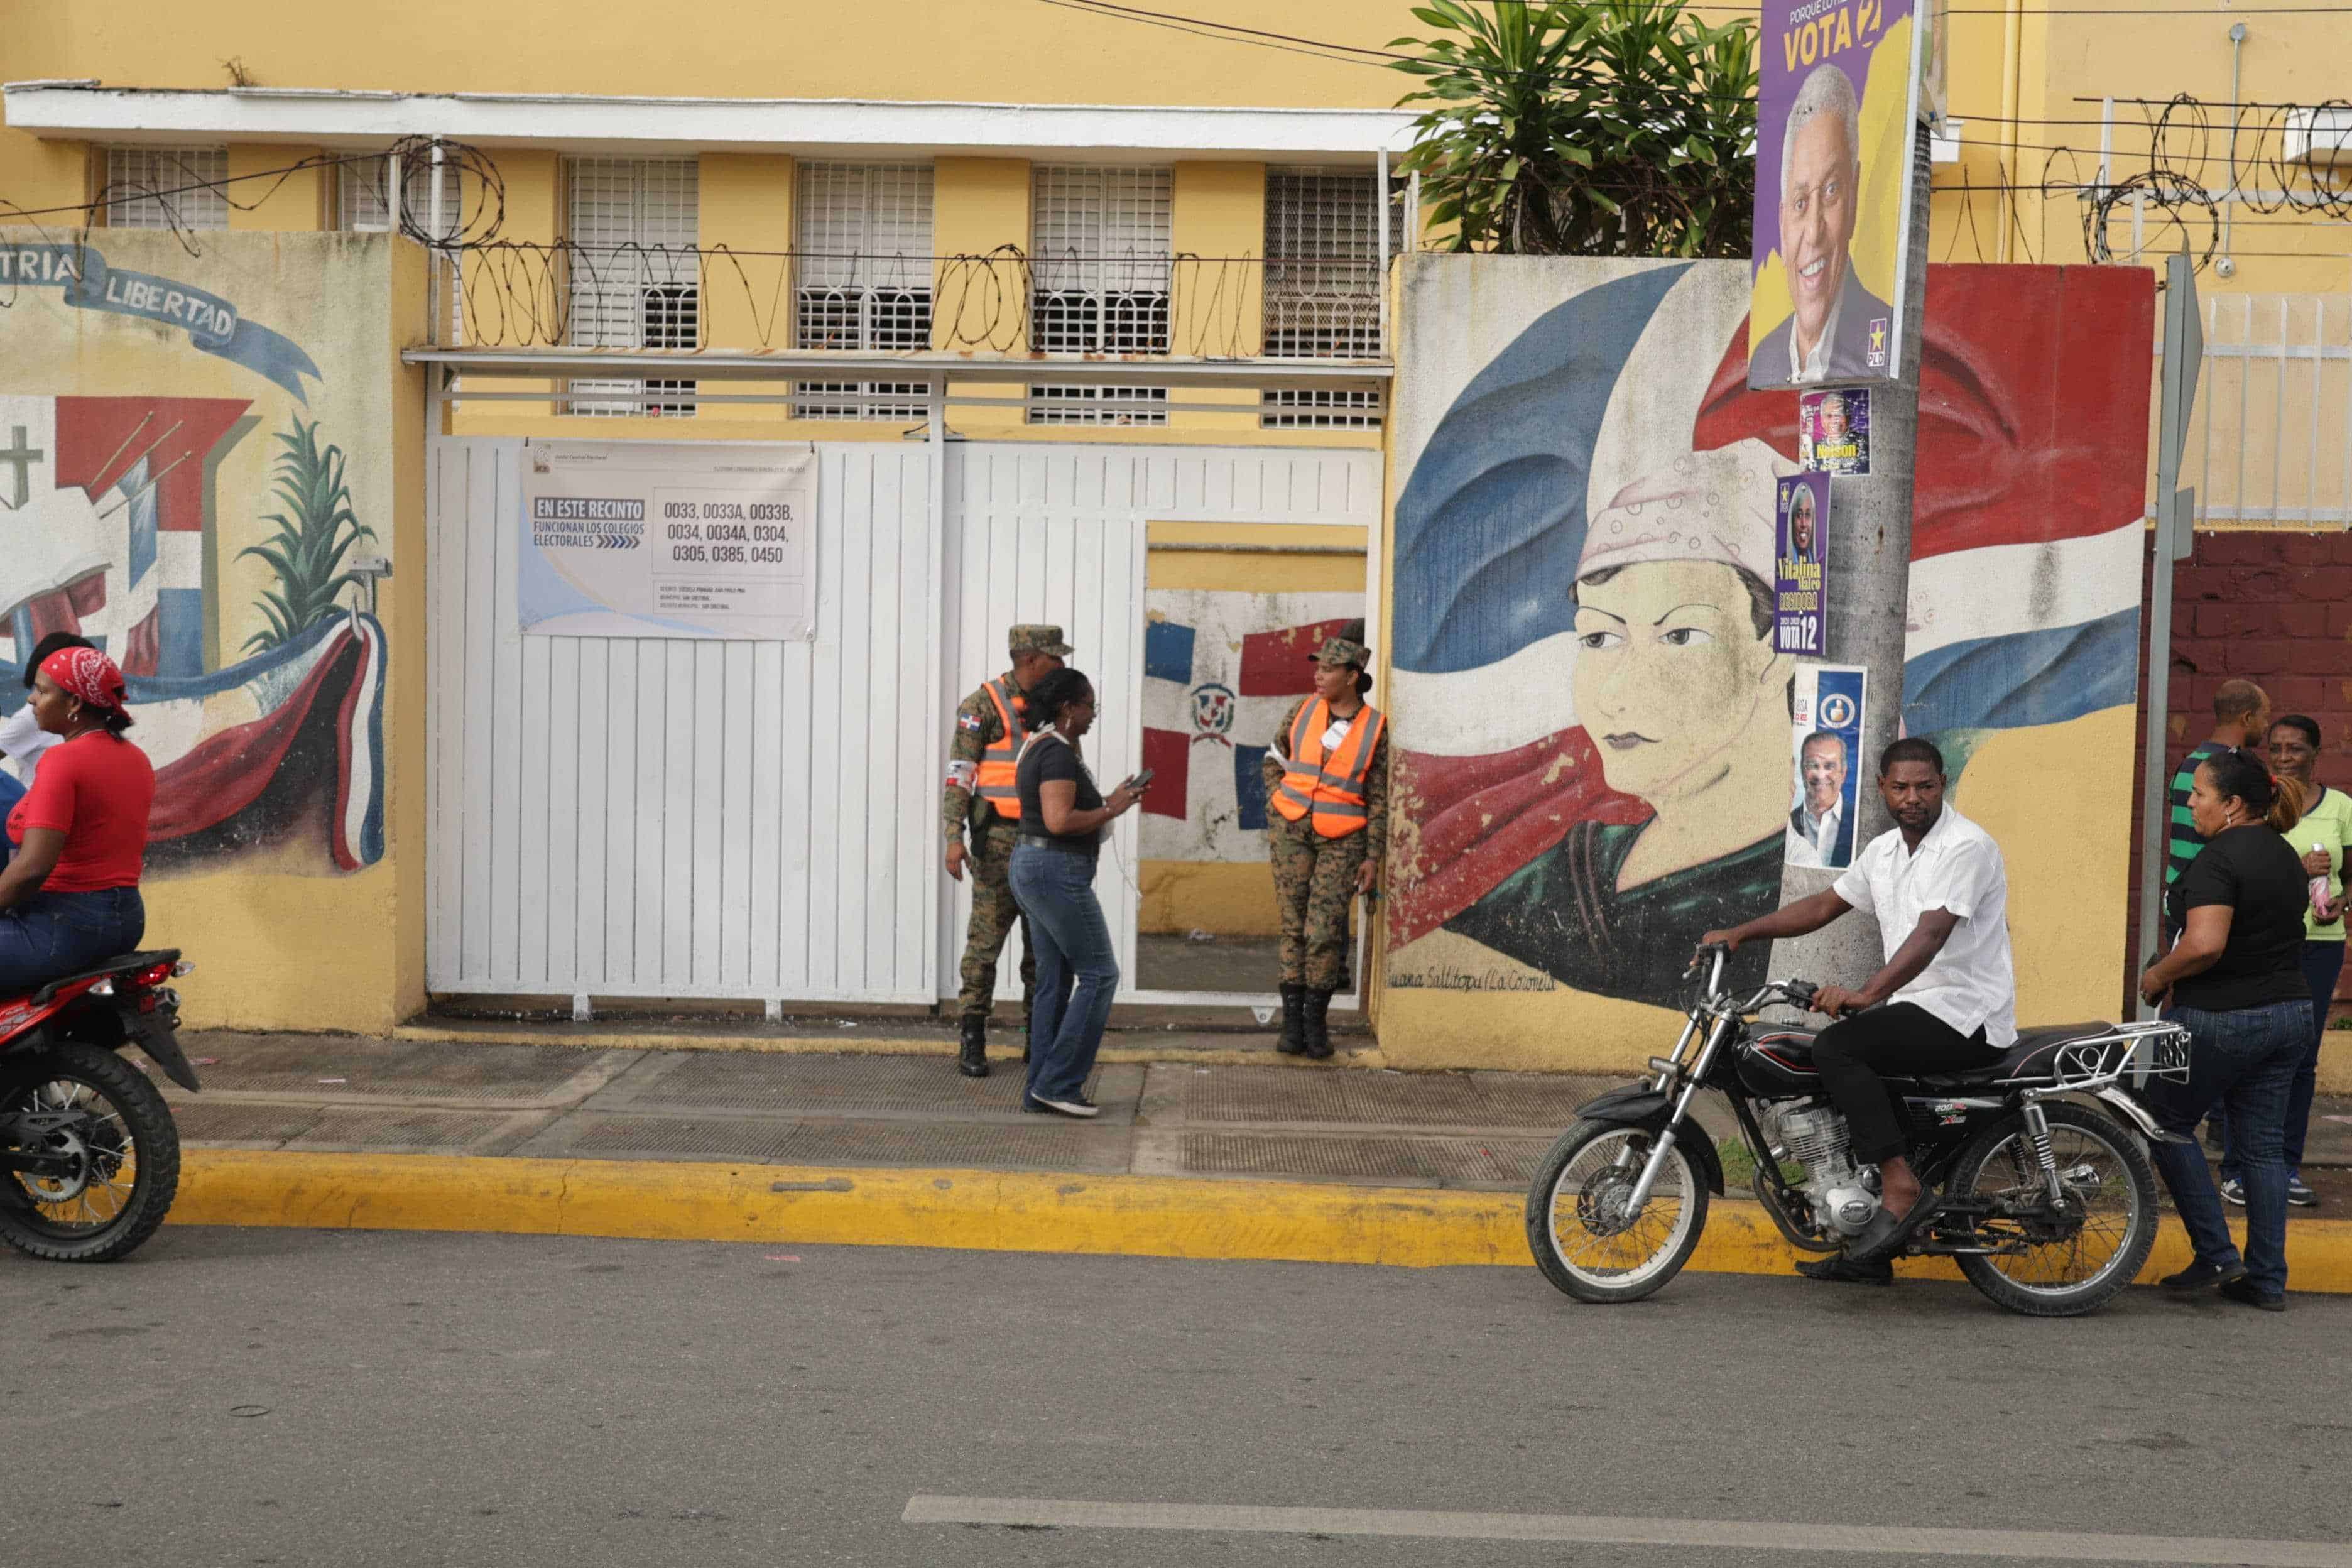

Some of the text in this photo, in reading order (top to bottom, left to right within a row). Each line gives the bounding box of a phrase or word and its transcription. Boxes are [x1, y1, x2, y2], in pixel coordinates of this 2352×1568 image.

[1790, 0, 1821, 25] PORQUE
[1783, 7, 1852, 72] VOTA
[105, 276, 233, 336] LIBERTAD
[1868, 352, 1884, 364] PLD
[537, 499, 643, 519] EN ESTE RECINTO
[664, 502, 793, 522] 0033, 0033A, 0033B,
[534, 521, 645, 534] FUNCIONAN LOS COLEGIOS
[668, 524, 788, 543] 0034, 0034A, 0304,
[534, 534, 594, 547] ELECTORALES
[673, 545, 783, 564] 0305, 0385, 0450
[1778, 555, 1821, 580] Vitalina
[1778, 591, 1818, 611] REGIDORA
[1780, 616, 1817, 650] VOTA 12
